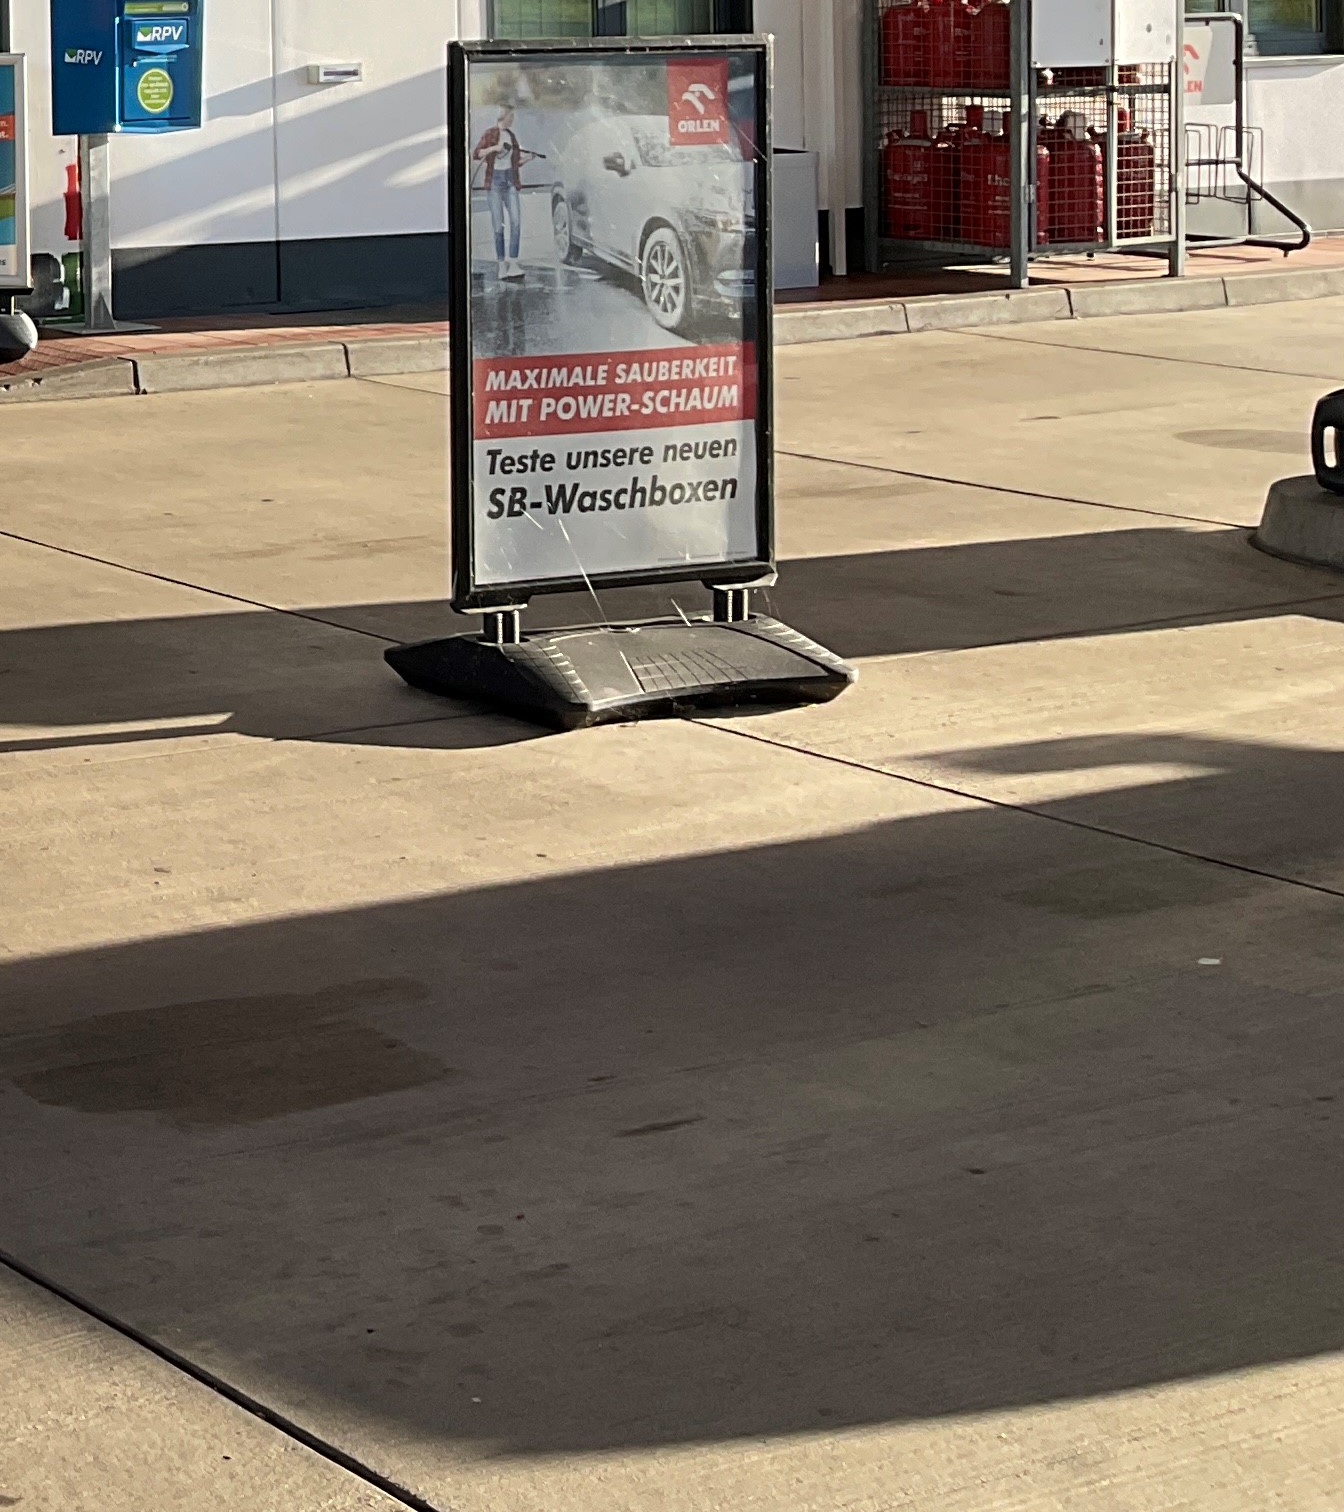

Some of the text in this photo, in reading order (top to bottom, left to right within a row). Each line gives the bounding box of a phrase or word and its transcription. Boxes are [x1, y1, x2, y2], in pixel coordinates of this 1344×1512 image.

[151, 25, 183, 41] RPV
[77, 49, 103, 65] RPV
[677, 119, 720, 133] ORLEN
[485, 355, 737, 392] MAXIMALE SAUBERKEIT
[485, 384, 738, 425] MIT POWER-SCHAUM
[486, 437, 737, 476] Teste unsere neuen
[486, 474, 738, 520] SB-Waschboxen
